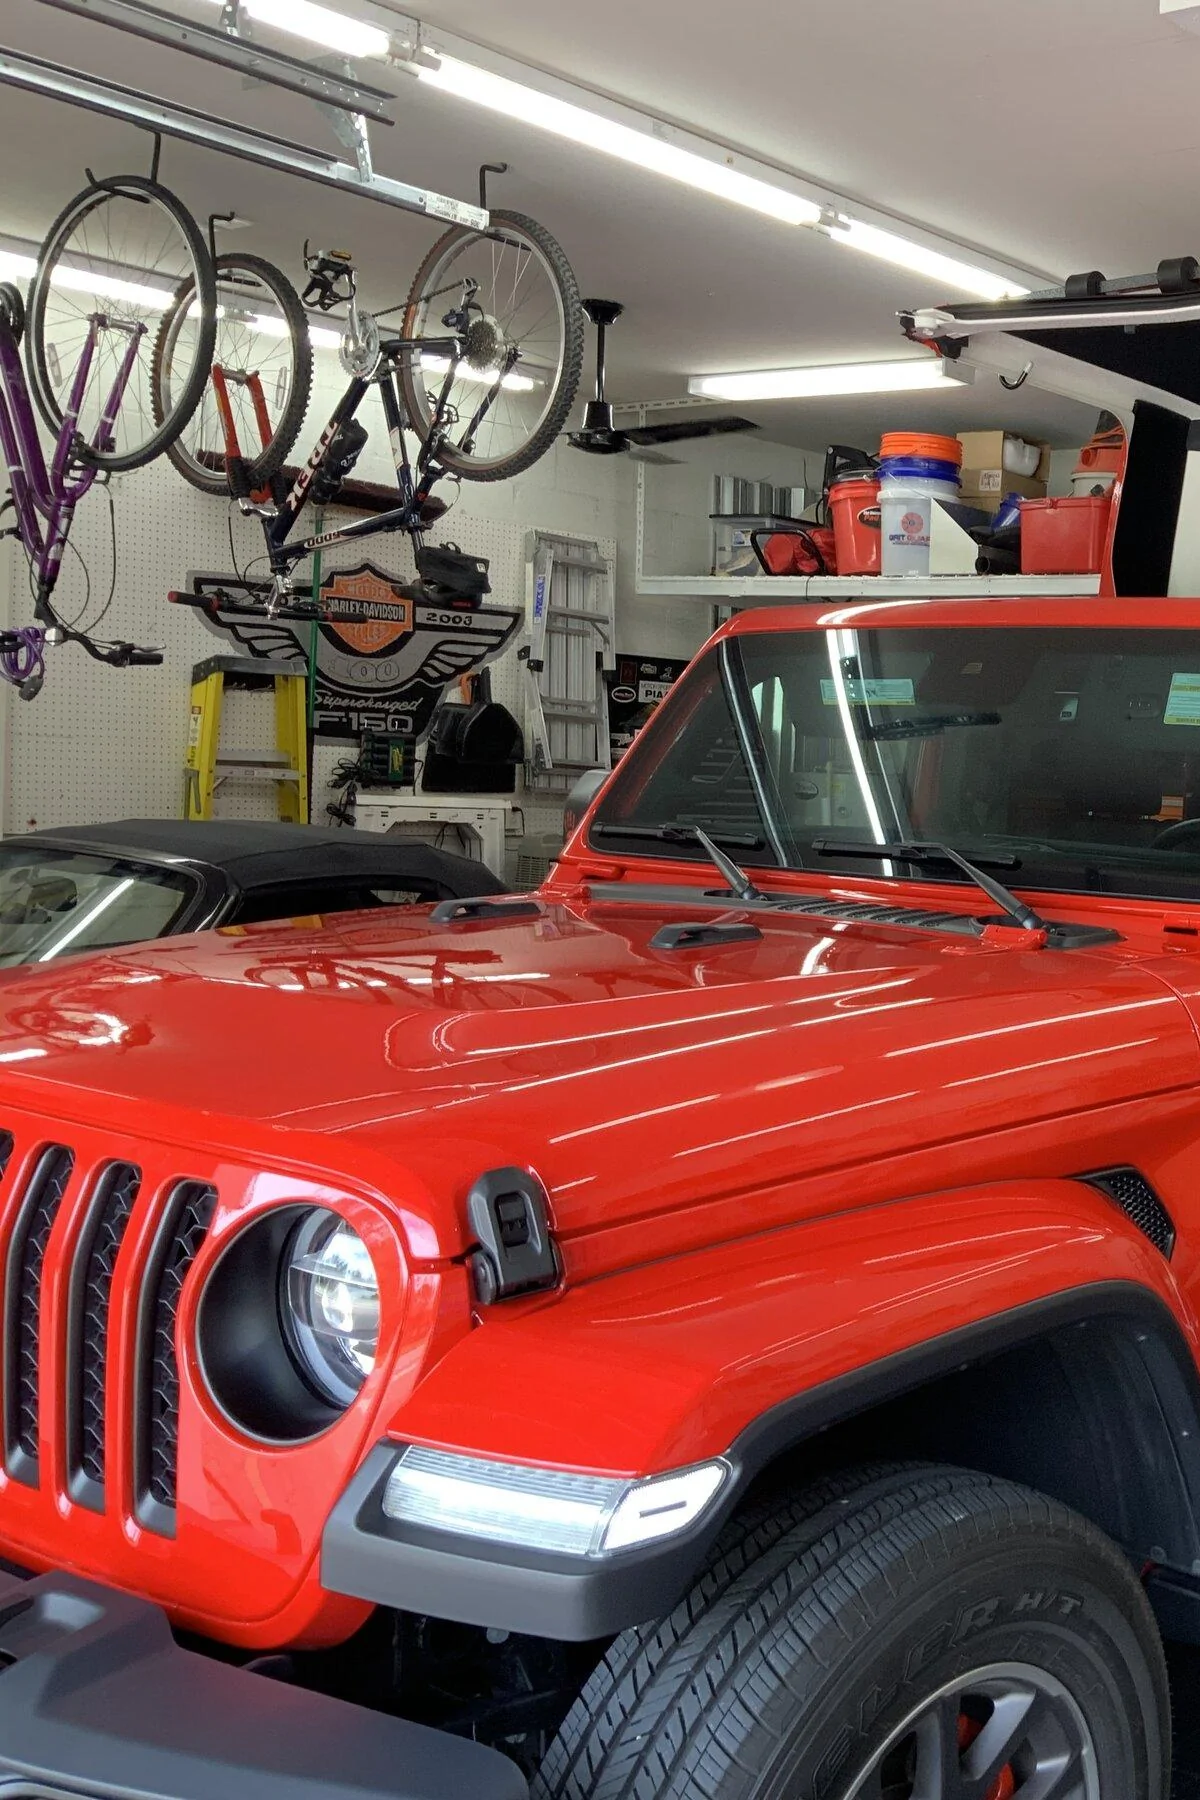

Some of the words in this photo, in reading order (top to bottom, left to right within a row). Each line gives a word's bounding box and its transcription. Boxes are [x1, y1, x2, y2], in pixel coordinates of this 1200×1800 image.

[286, 421, 341, 512] TREK
[426, 612, 473, 626] 2003
[314, 689, 424, 713] Supercharged
[812, 1594, 1005, 1800] ELER
[1012, 1591, 1084, 1615] H/T
